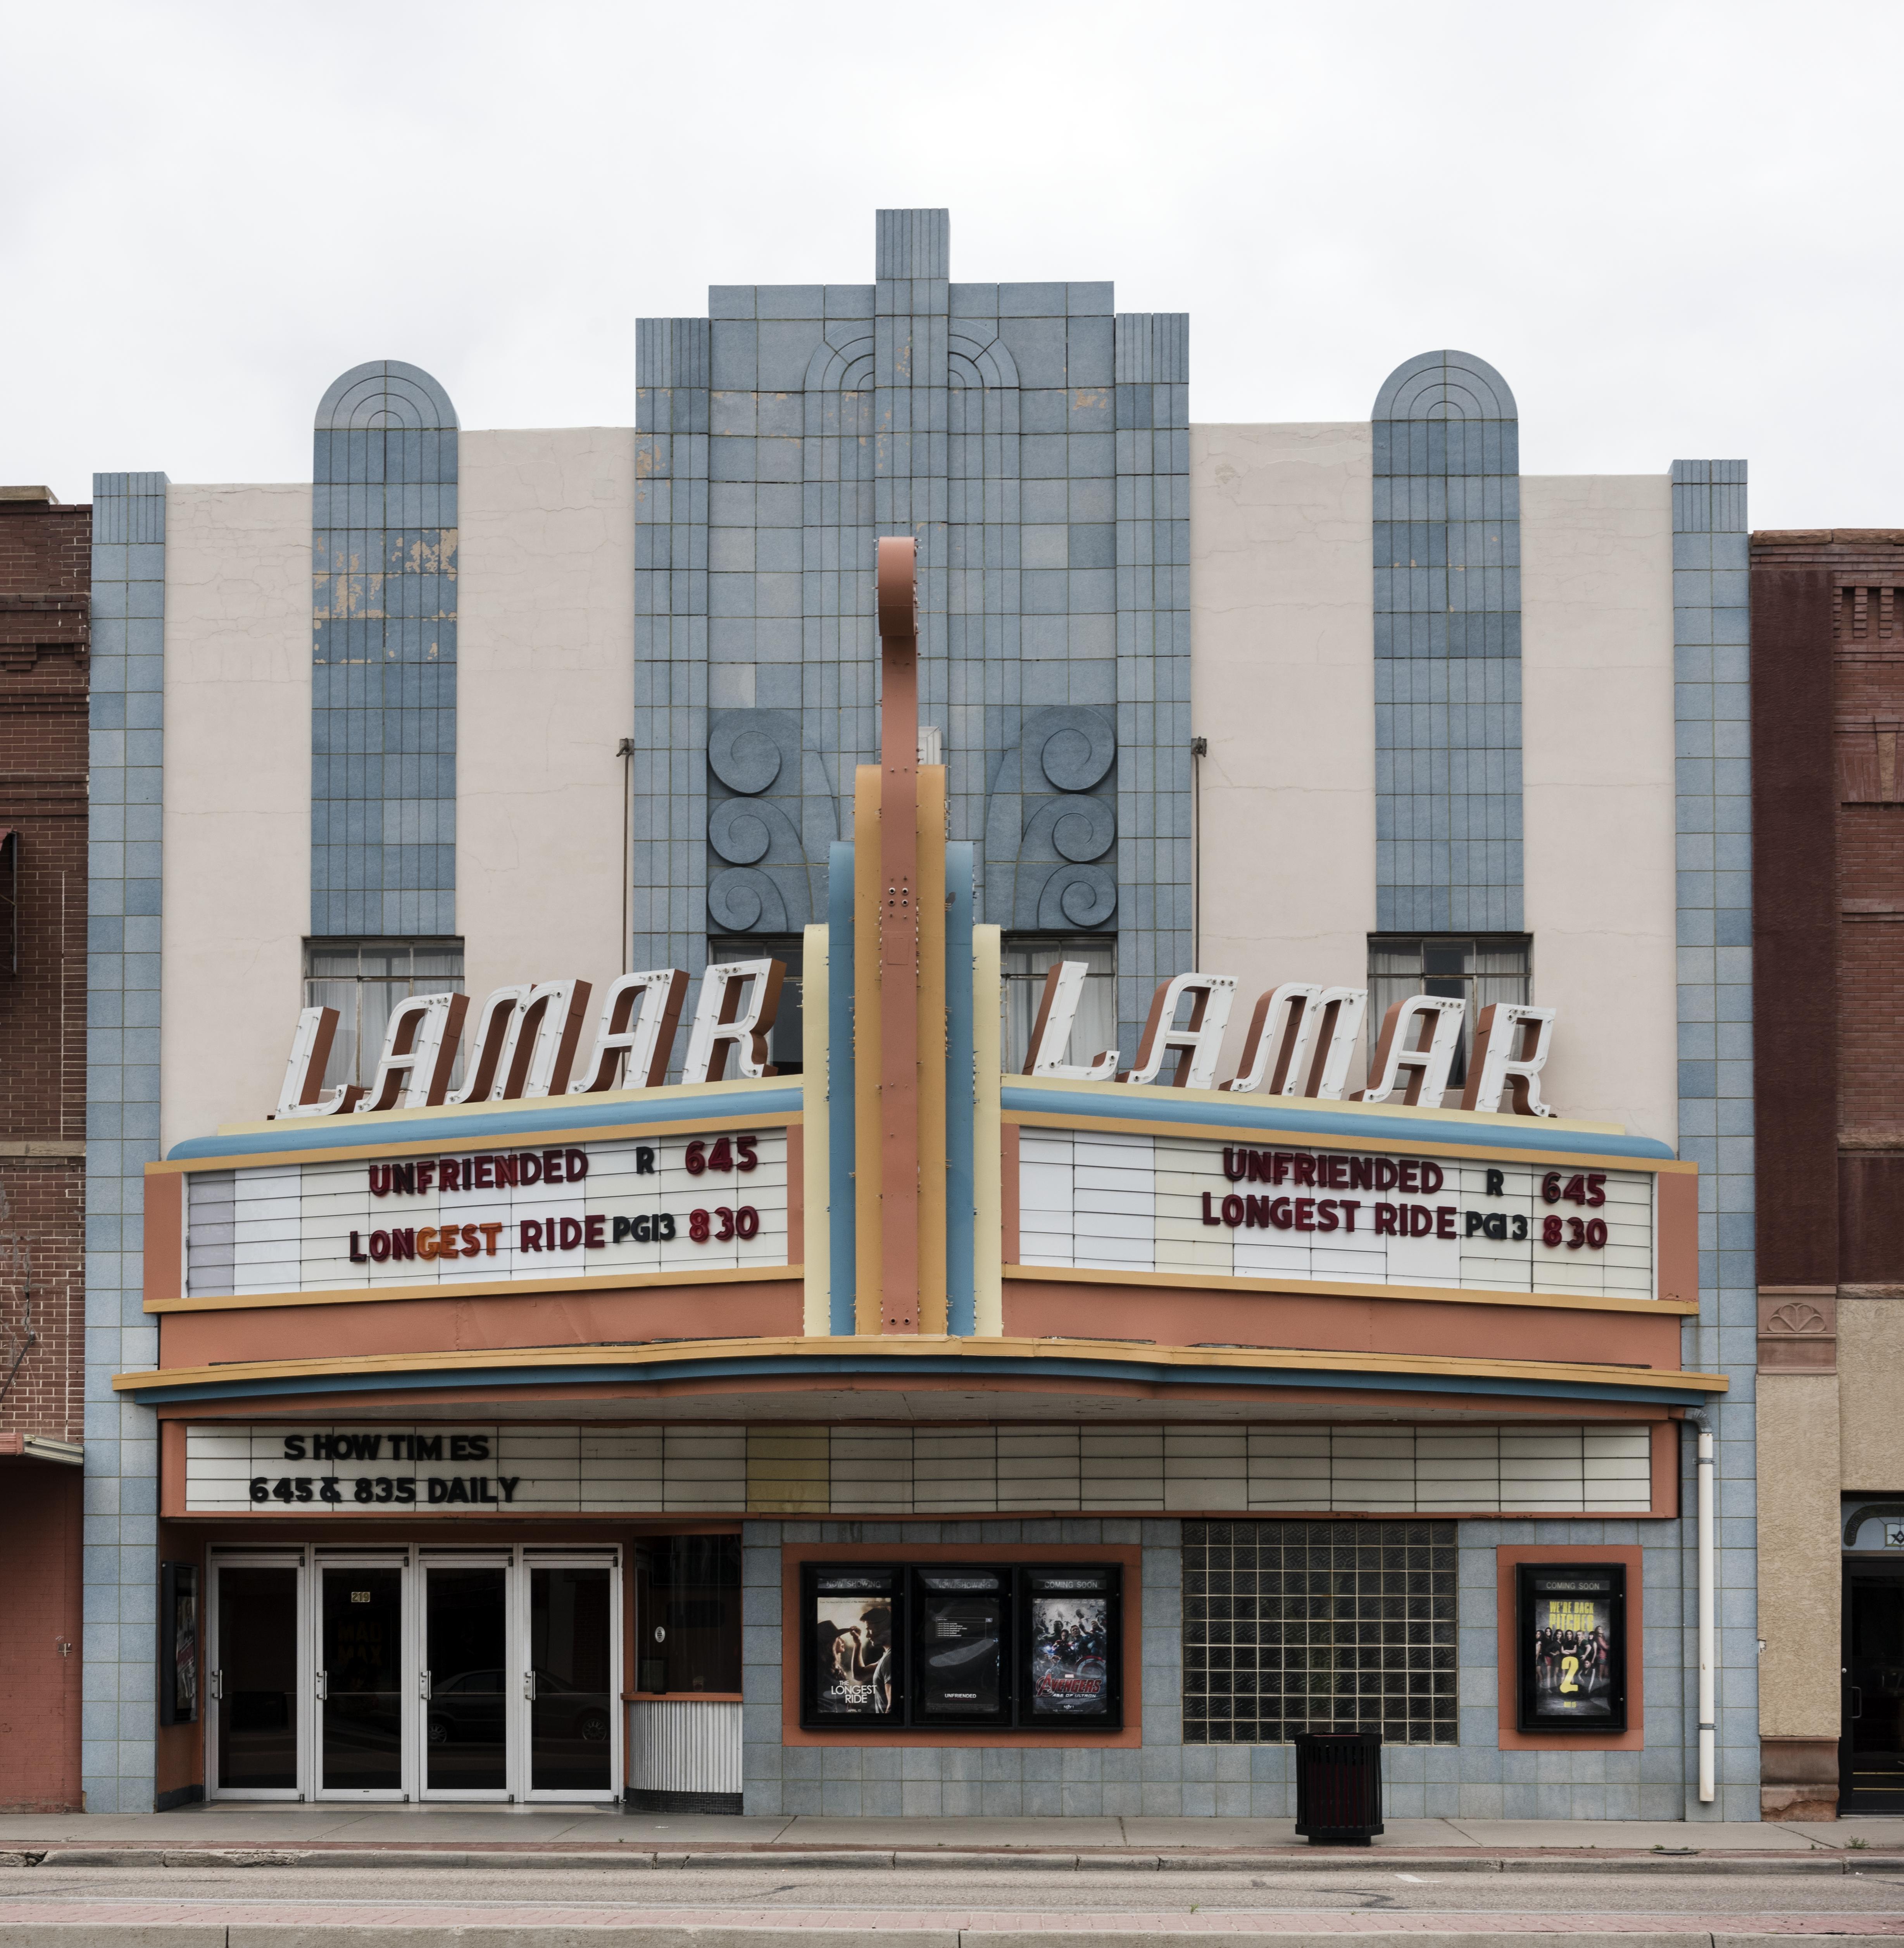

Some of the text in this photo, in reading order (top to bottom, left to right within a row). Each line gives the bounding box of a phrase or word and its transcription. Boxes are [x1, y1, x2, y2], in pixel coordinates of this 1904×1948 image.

[274, 958, 786, 1120] LAMAR
[1025, 960, 1556, 1117] LAMAR
[369, 1136, 758, 1196] UNFRIENDED R 645
[1224, 1147, 1606, 1207] UNFRIENDED R 645
[350, 1205, 759, 1262] LONGEST RIDE PG13 830
[1203, 1191, 1608, 1249] LONGEST RIDE PG13 830
[354, 1477, 416, 1503] 835
[428, 1477, 520, 1503] DAILY
[352, 1592, 369, 1601] 219
[1574, 1601, 1594, 1614] BACK
[1549, 1613, 1594, 1631] PITCHES
[831, 1685, 877, 1695] LONGEST
[1036, 1673, 1102, 1696] AVENGERS
[1560, 1656, 1578, 1693] 2
[845, 1694, 867, 1703] RIDE
